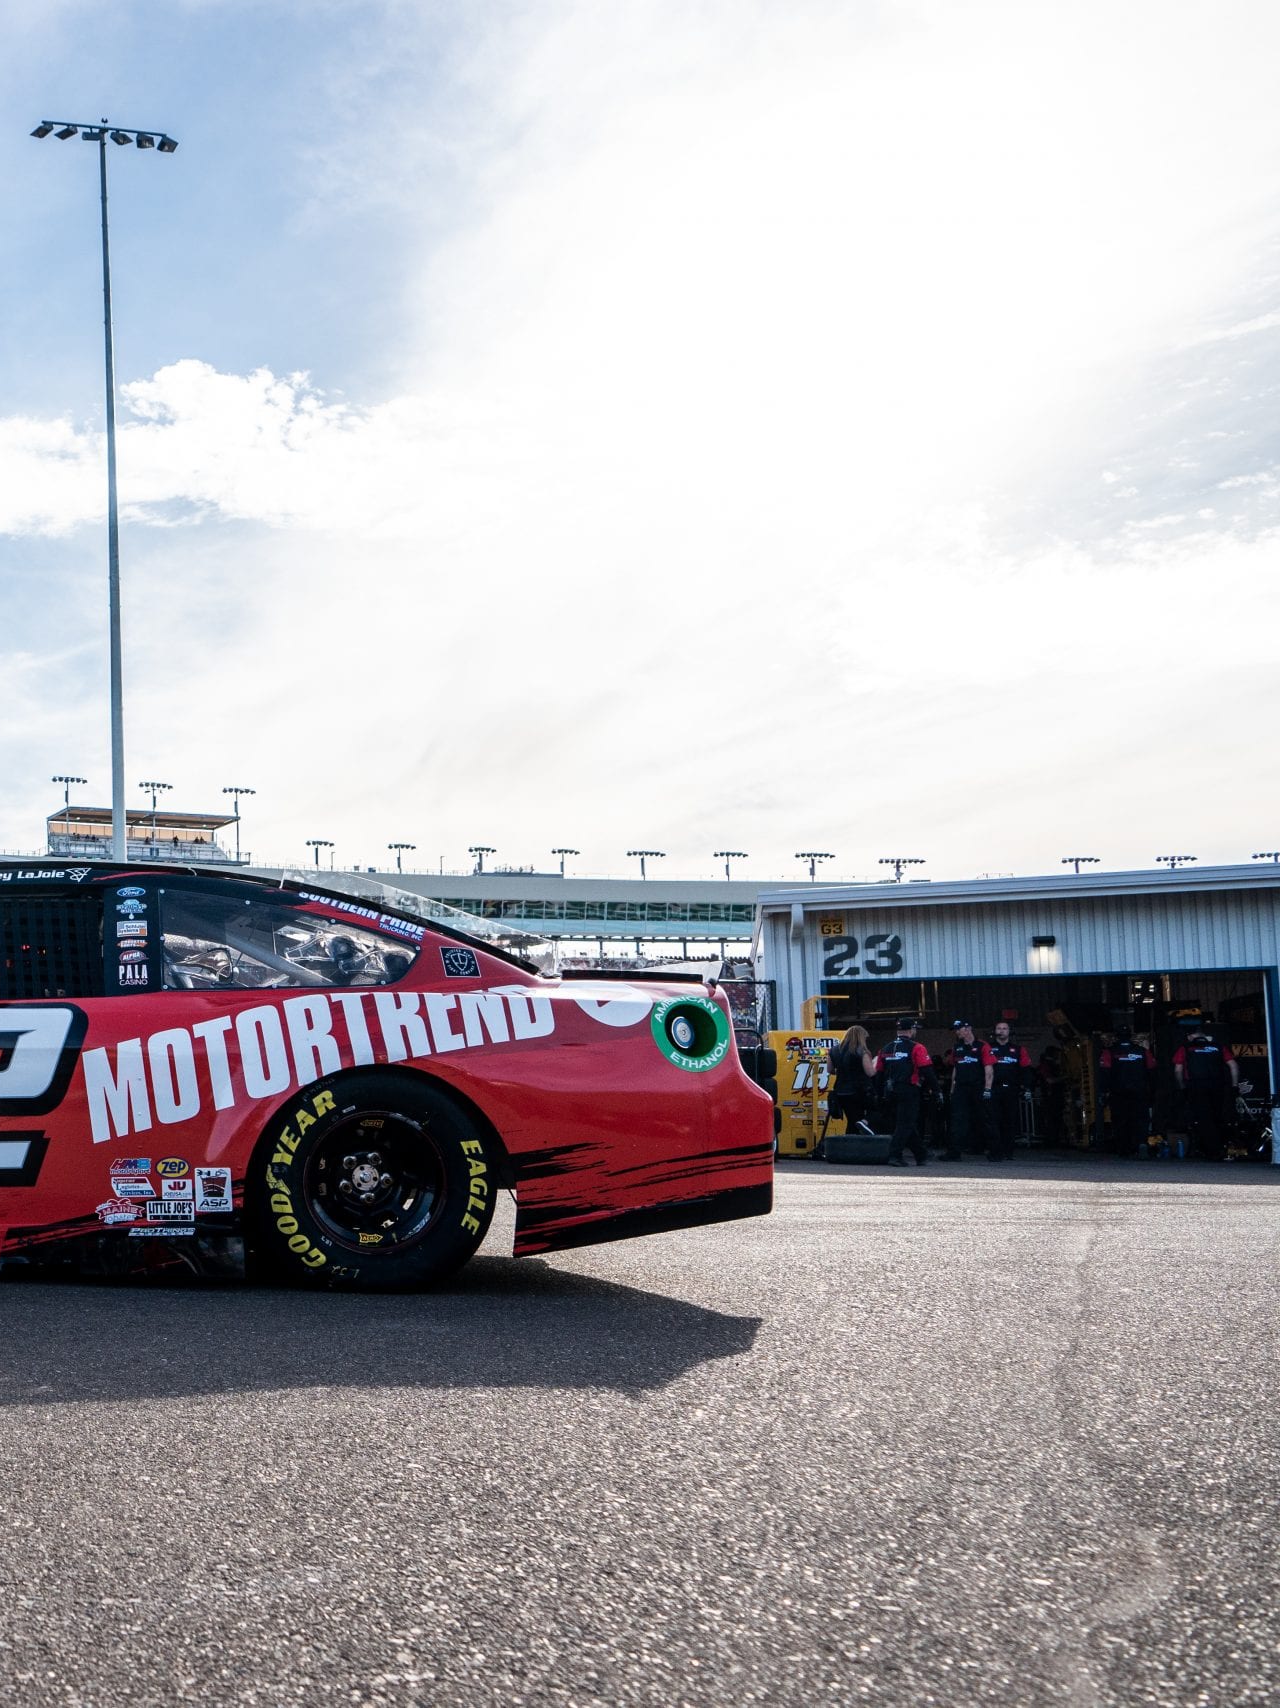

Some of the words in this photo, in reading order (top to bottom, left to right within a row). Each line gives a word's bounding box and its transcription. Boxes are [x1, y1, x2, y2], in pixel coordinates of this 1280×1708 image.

[17, 870, 65, 879] LaJoie
[380, 914, 425, 936] PRIDE
[821, 923, 843, 935] G3
[823, 934, 903, 976] 23
[119, 965, 148, 979] PALA
[654, 995, 718, 1023] AMERICAN
[670, 1039, 728, 1069] ETHANOL
[82, 985, 555, 1144] MOTORTREND
[460, 1139, 488, 1236] EAGLE
[102, 1205, 138, 1215] MAINE
[148, 1202, 170, 1214] LITTLE
[173, 1202, 193, 1214] JOE'S
[200, 1199, 228, 1207] ASP
